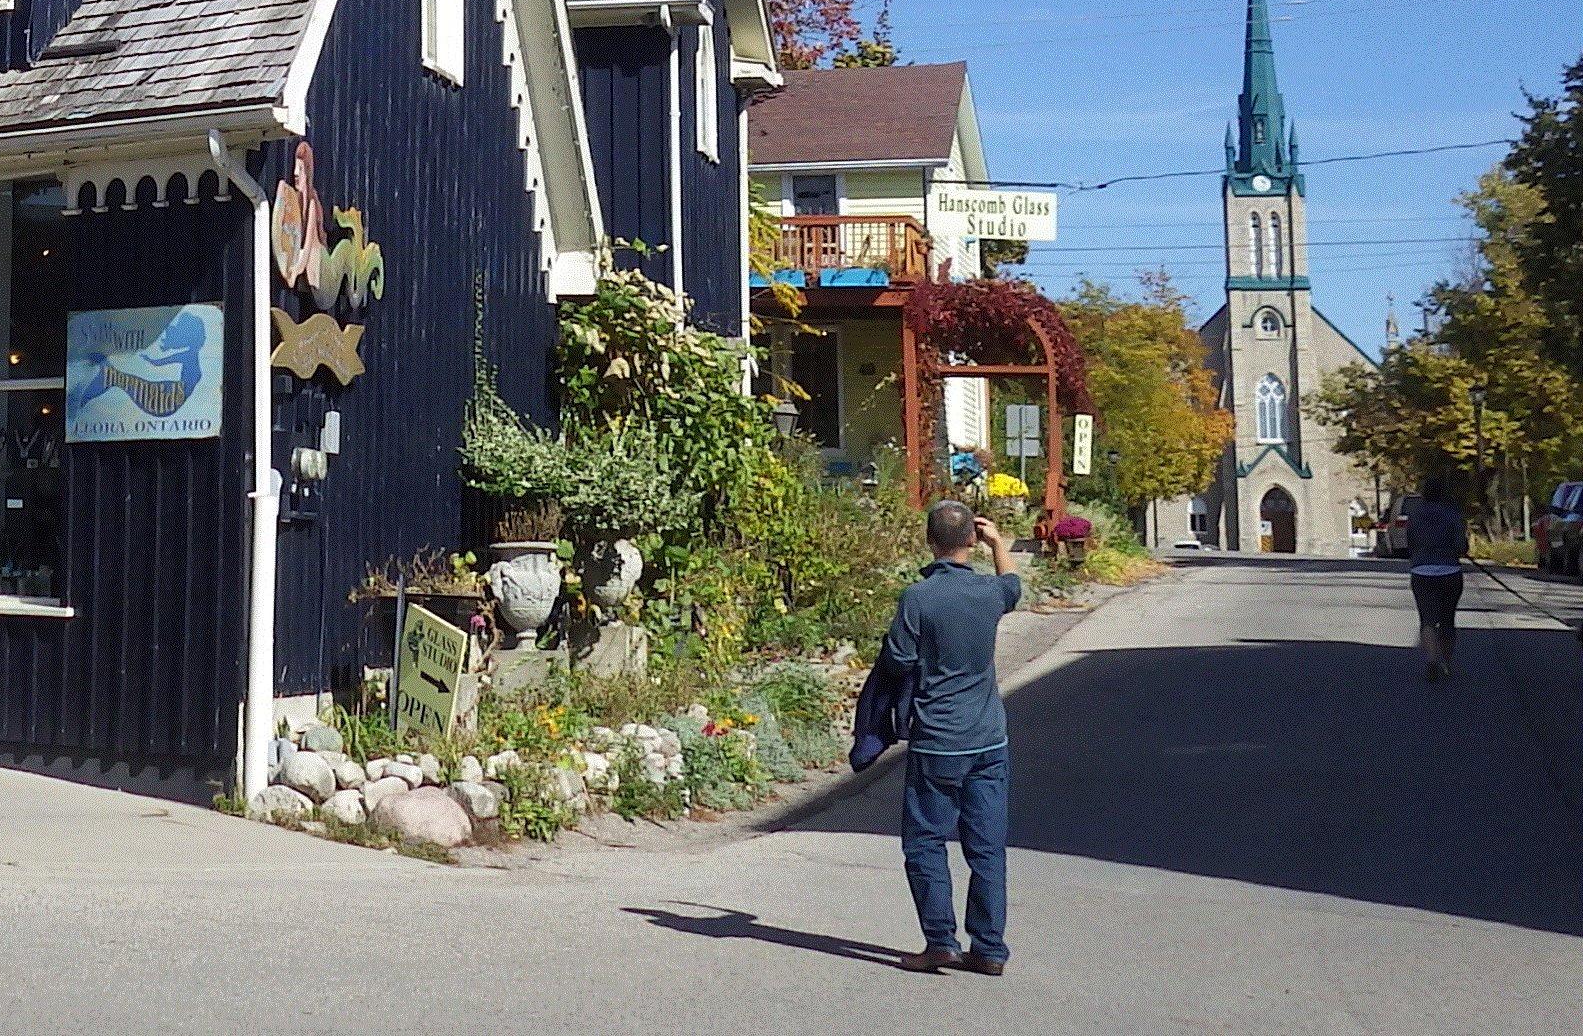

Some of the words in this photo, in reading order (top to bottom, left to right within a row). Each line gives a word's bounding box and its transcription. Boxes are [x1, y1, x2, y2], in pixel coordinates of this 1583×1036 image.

[938, 193, 1006, 214] Hanscomb
[1013, 195, 1049, 216] Glass
[967, 214, 1027, 237] Studio
[112, 328, 146, 351] WITH
[104, 366, 186, 414] mermaids
[134, 418, 212, 433] ONTARIO
[1077, 418, 1090, 470] OPEN
[426, 626, 458, 656] GLASS
[421, 641, 458, 674] STUDIO
[397, 689, 447, 734] OPEN
